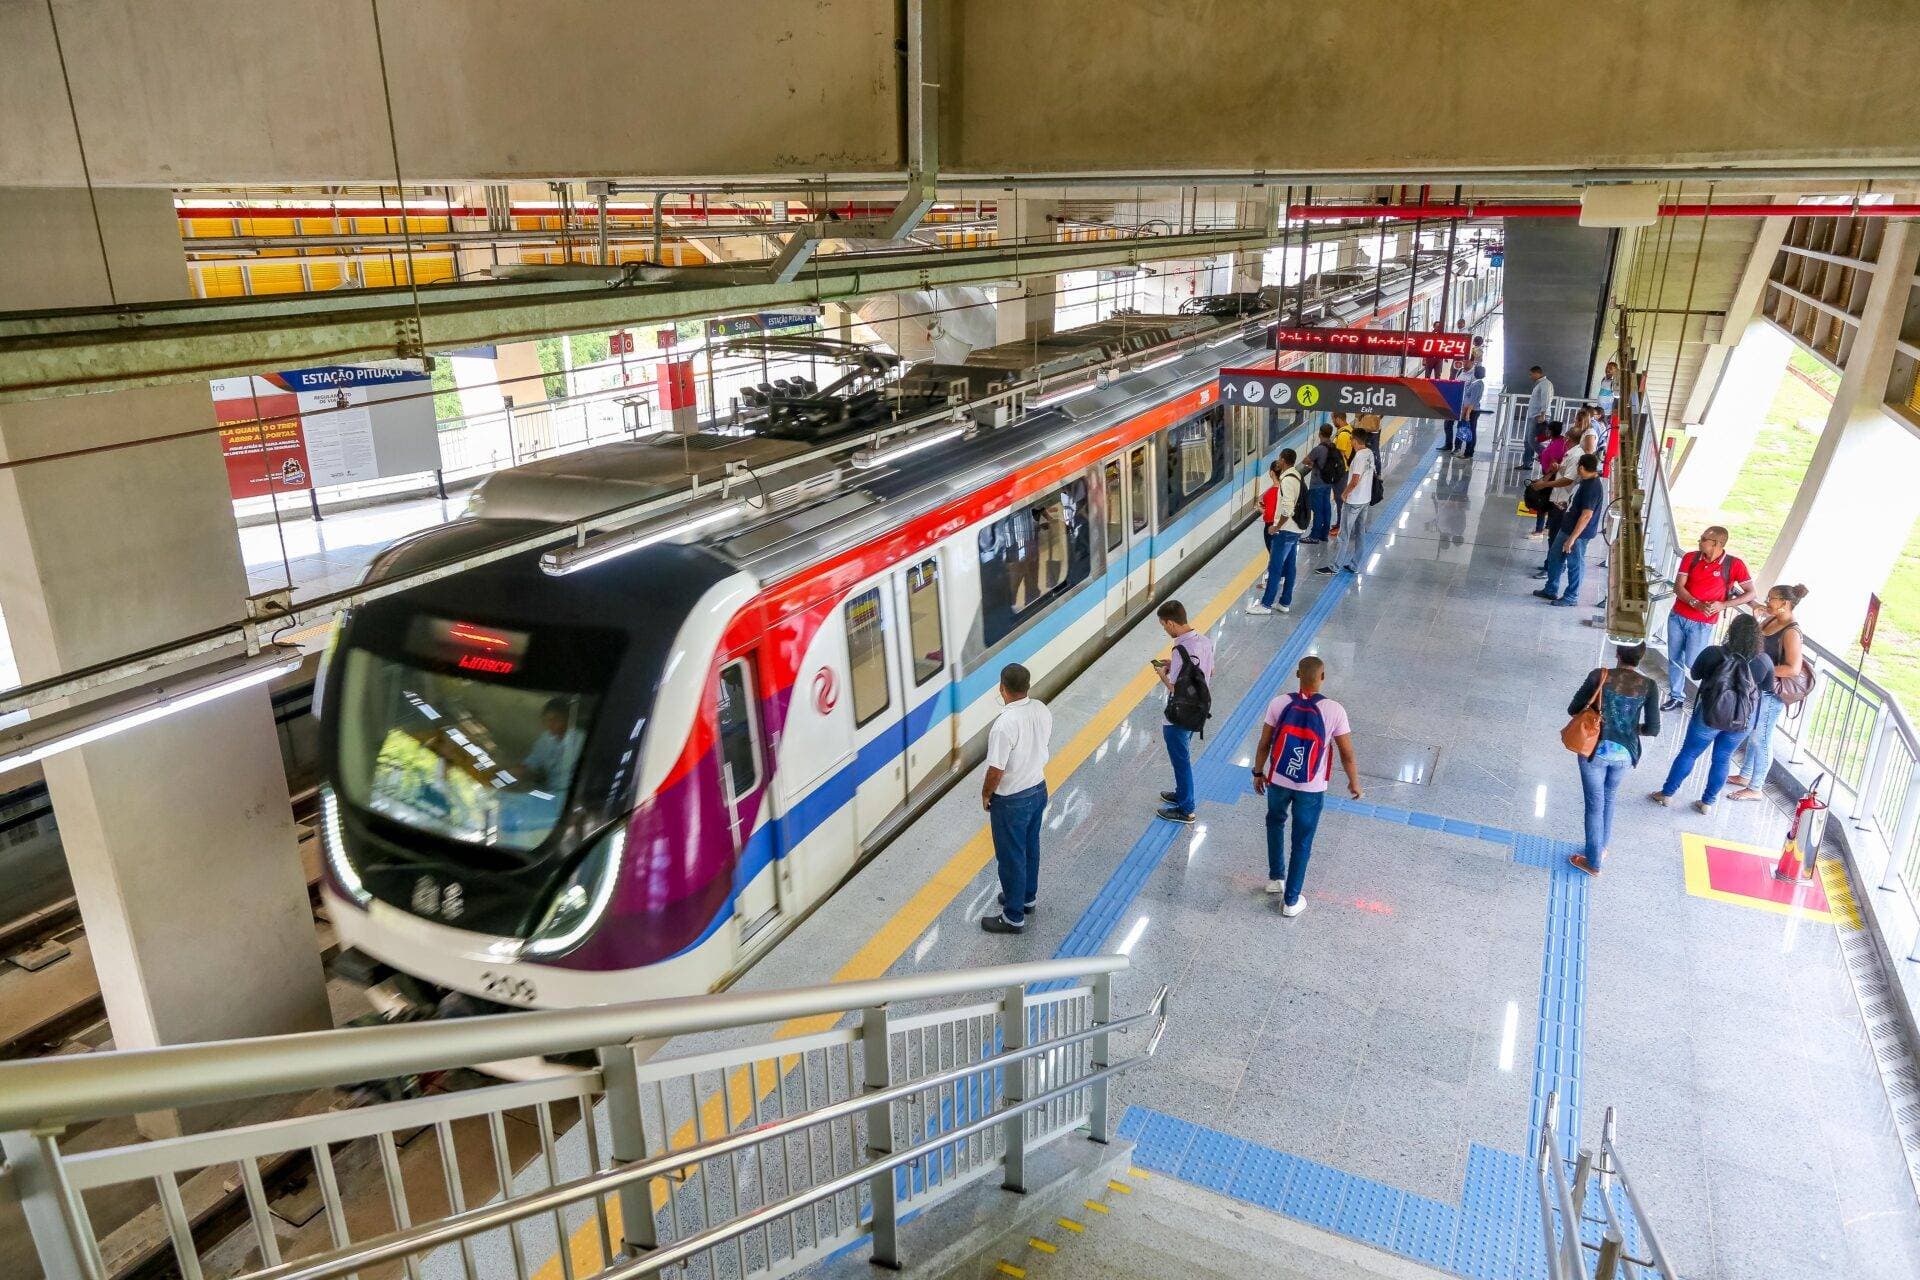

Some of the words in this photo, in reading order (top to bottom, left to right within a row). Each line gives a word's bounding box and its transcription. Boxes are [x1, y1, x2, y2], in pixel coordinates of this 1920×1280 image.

[1423, 339, 1465, 353] 07:24
[302, 369, 354, 385] ESTAÇÃO
[357, 368, 403, 380] PITUAÇU
[1339, 386, 1396, 407] Saída
[1286, 747, 1304, 778] FILA
